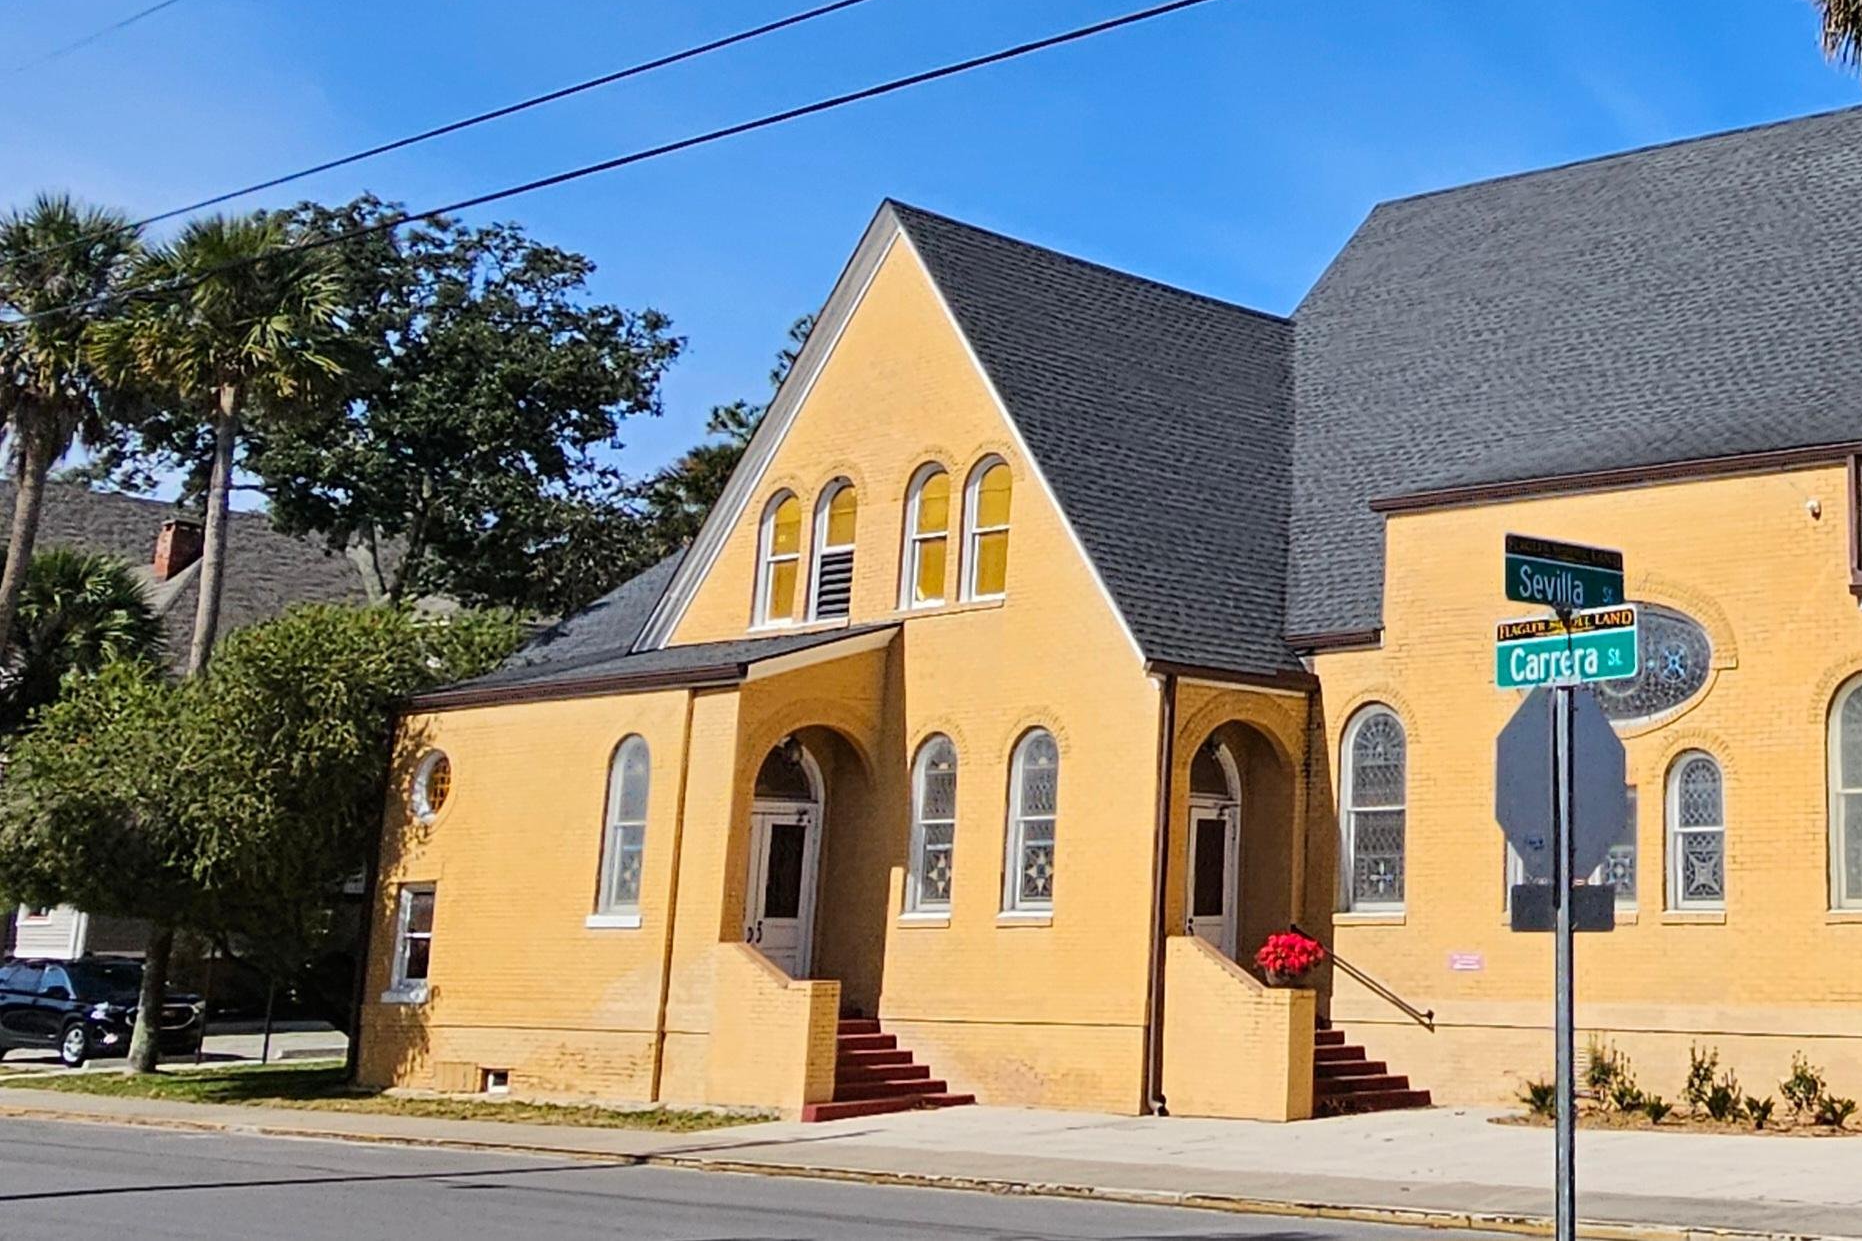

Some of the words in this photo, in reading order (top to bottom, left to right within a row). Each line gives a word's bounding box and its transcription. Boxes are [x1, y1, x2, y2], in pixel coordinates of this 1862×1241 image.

[1519, 564, 1584, 606] Sevilla
[1499, 621, 1546, 639] FLAGLER
[1594, 610, 1633, 626] LAND
[1510, 646, 1599, 682] Carrera
